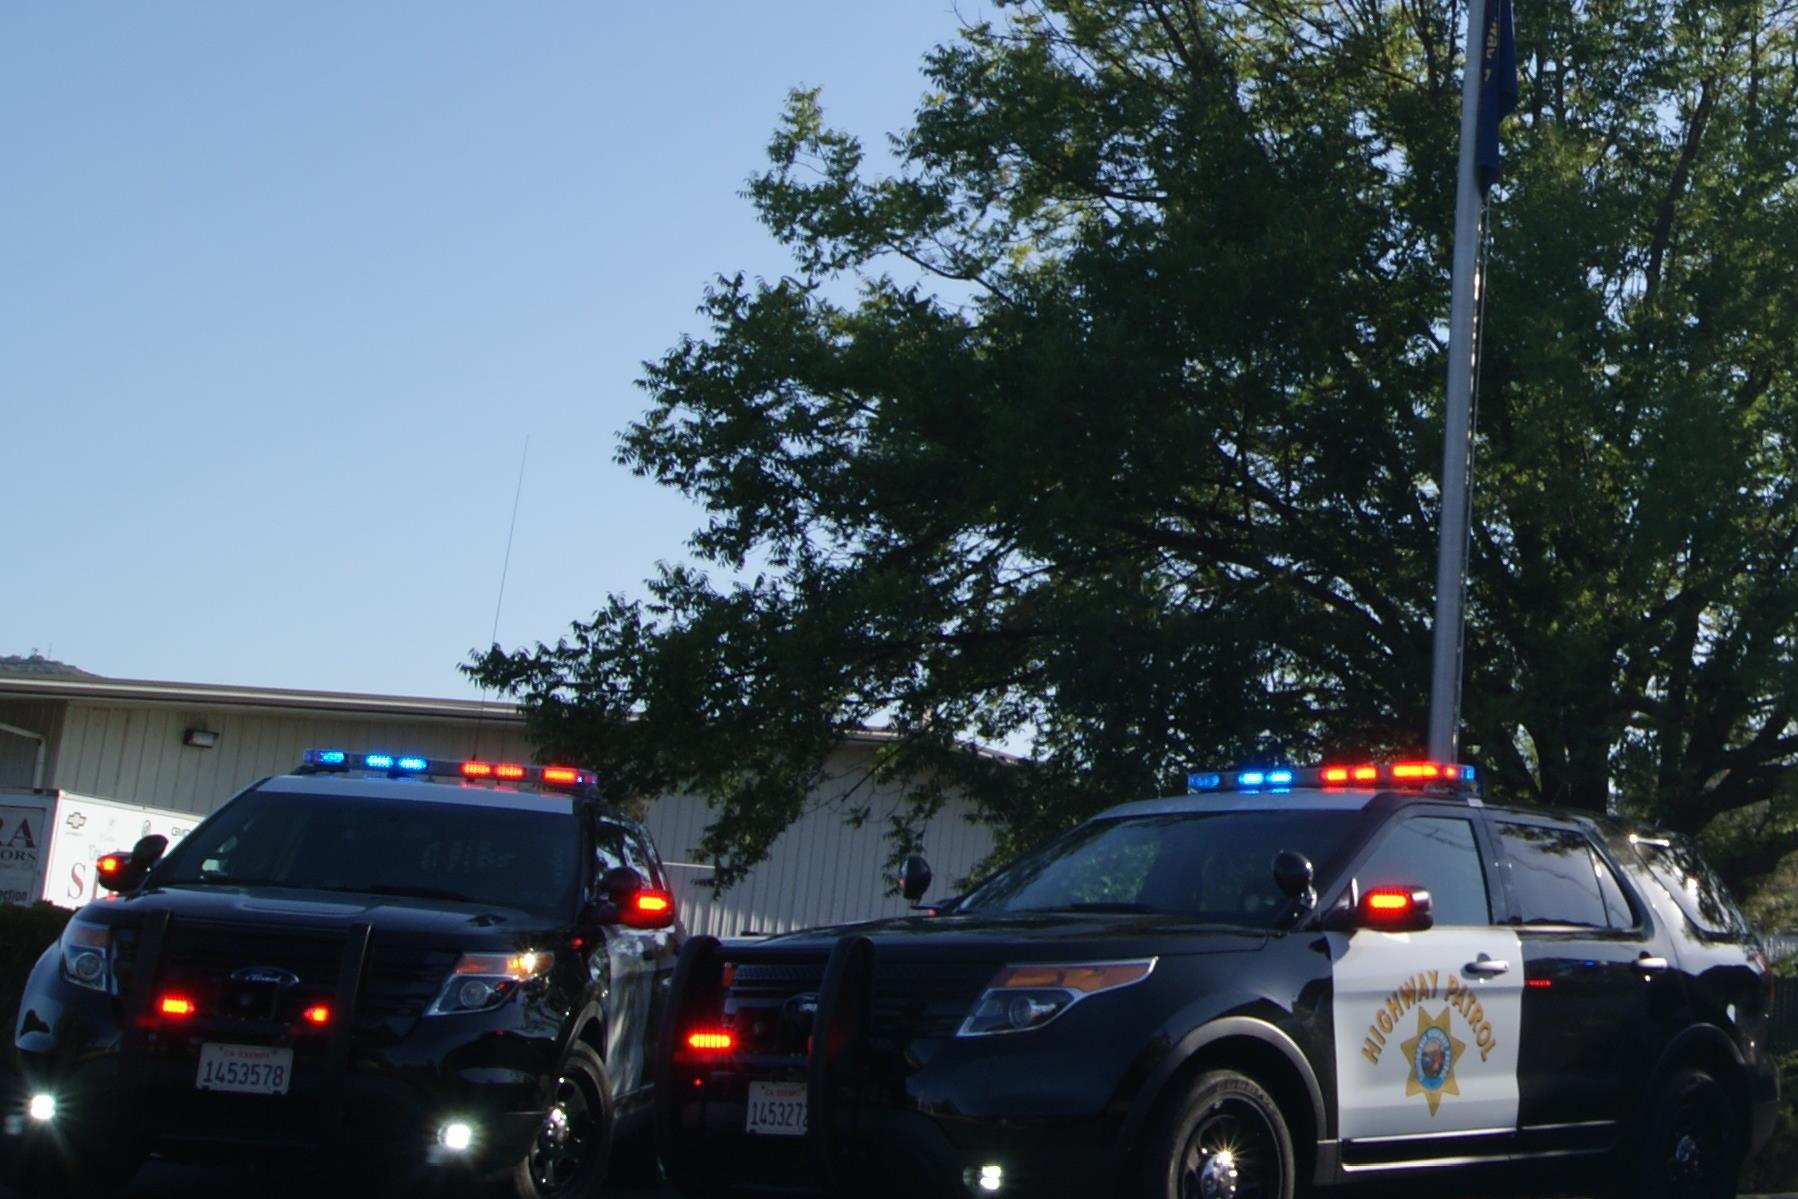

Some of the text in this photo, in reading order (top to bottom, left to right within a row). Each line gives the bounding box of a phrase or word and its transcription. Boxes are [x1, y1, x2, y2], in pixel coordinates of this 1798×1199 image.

[1360, 968, 1439, 1067] HIGHWAY
[1443, 974, 1497, 1063] PATROL
[202, 1060, 285, 1088] 1453578
